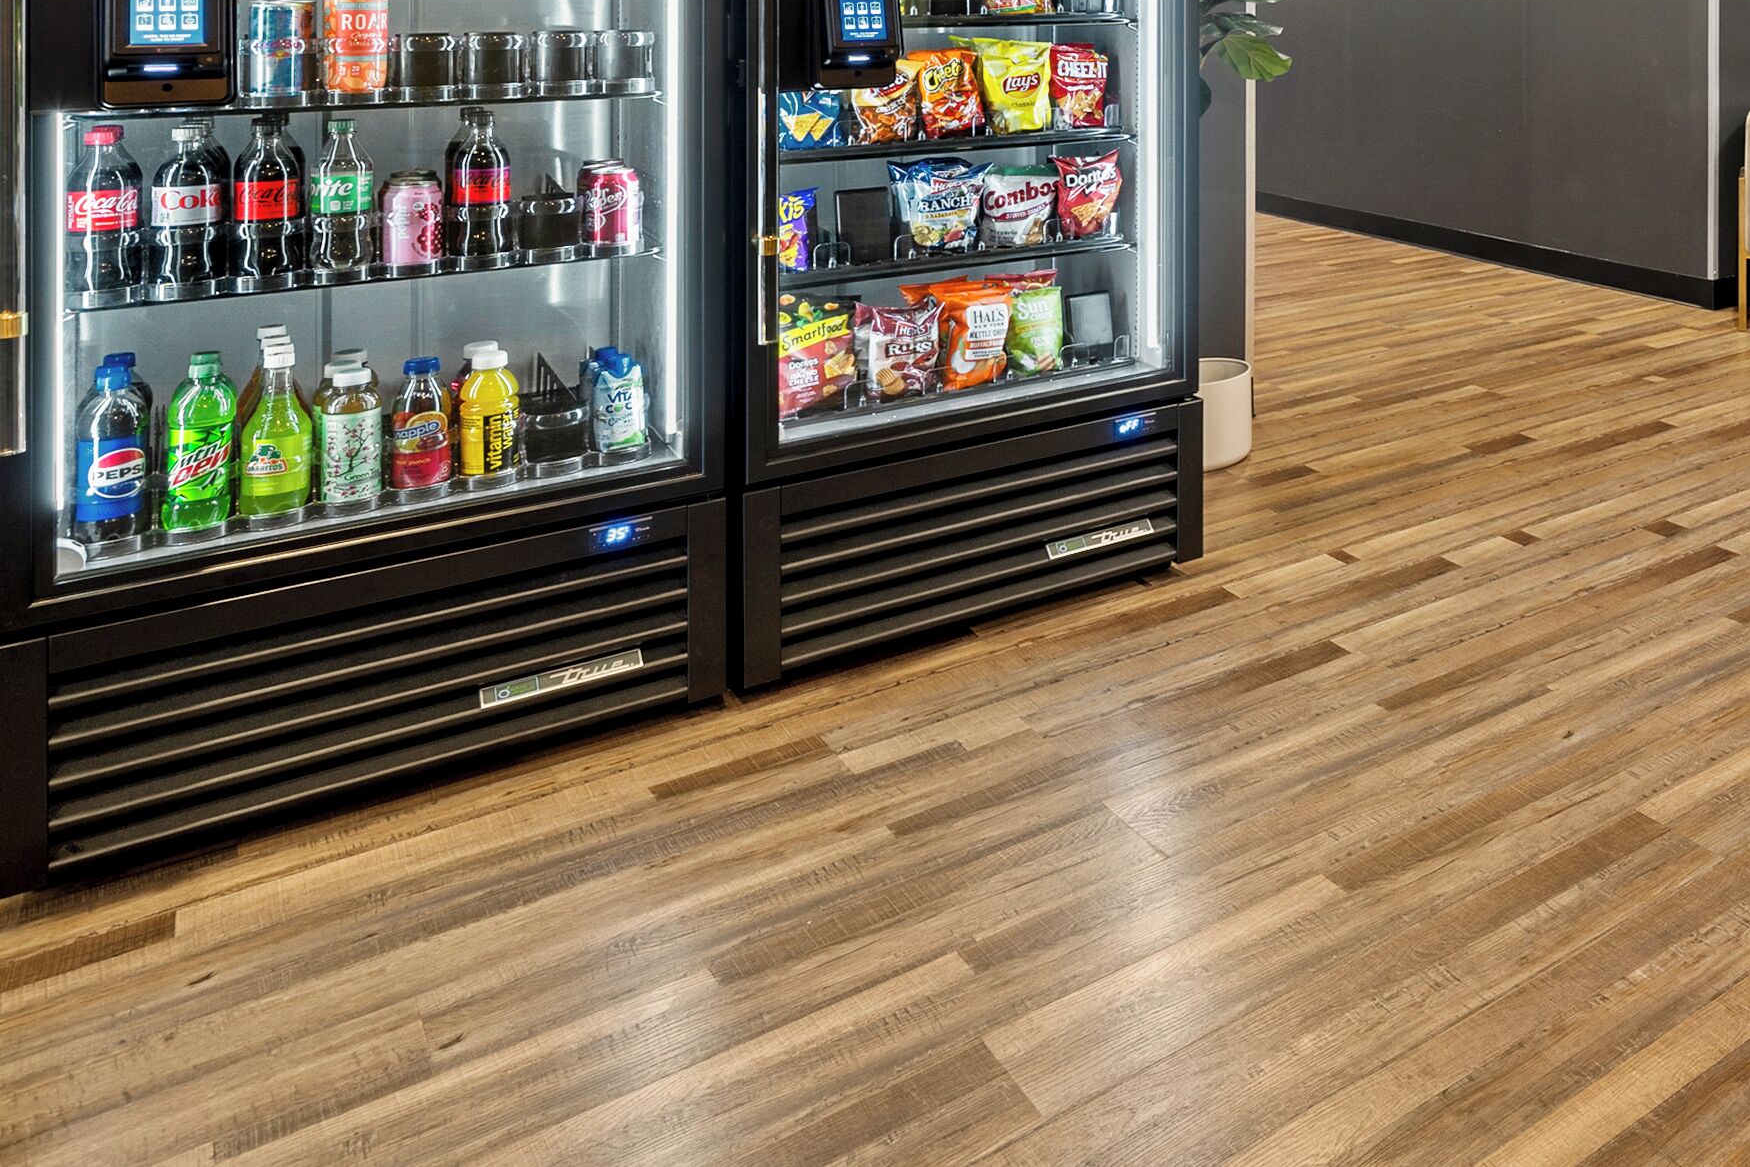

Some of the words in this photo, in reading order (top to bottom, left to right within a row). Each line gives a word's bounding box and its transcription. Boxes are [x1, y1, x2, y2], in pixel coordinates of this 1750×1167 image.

[341, 13, 387, 31] ROAR
[924, 59, 964, 93] Cheeto
[1004, 73, 1039, 92] Lay's
[1066, 166, 1117, 188] Doritos
[779, 196, 805, 224] kis
[921, 194, 973, 211] RANCH
[973, 308, 1005, 324] HAL'S
[782, 320, 845, 351] Smartfood
[605, 402, 632, 414] COC
[395, 422, 439, 440] napple
[486, 415, 502, 470] vitamin
[93, 462, 145, 481] PEPSI
